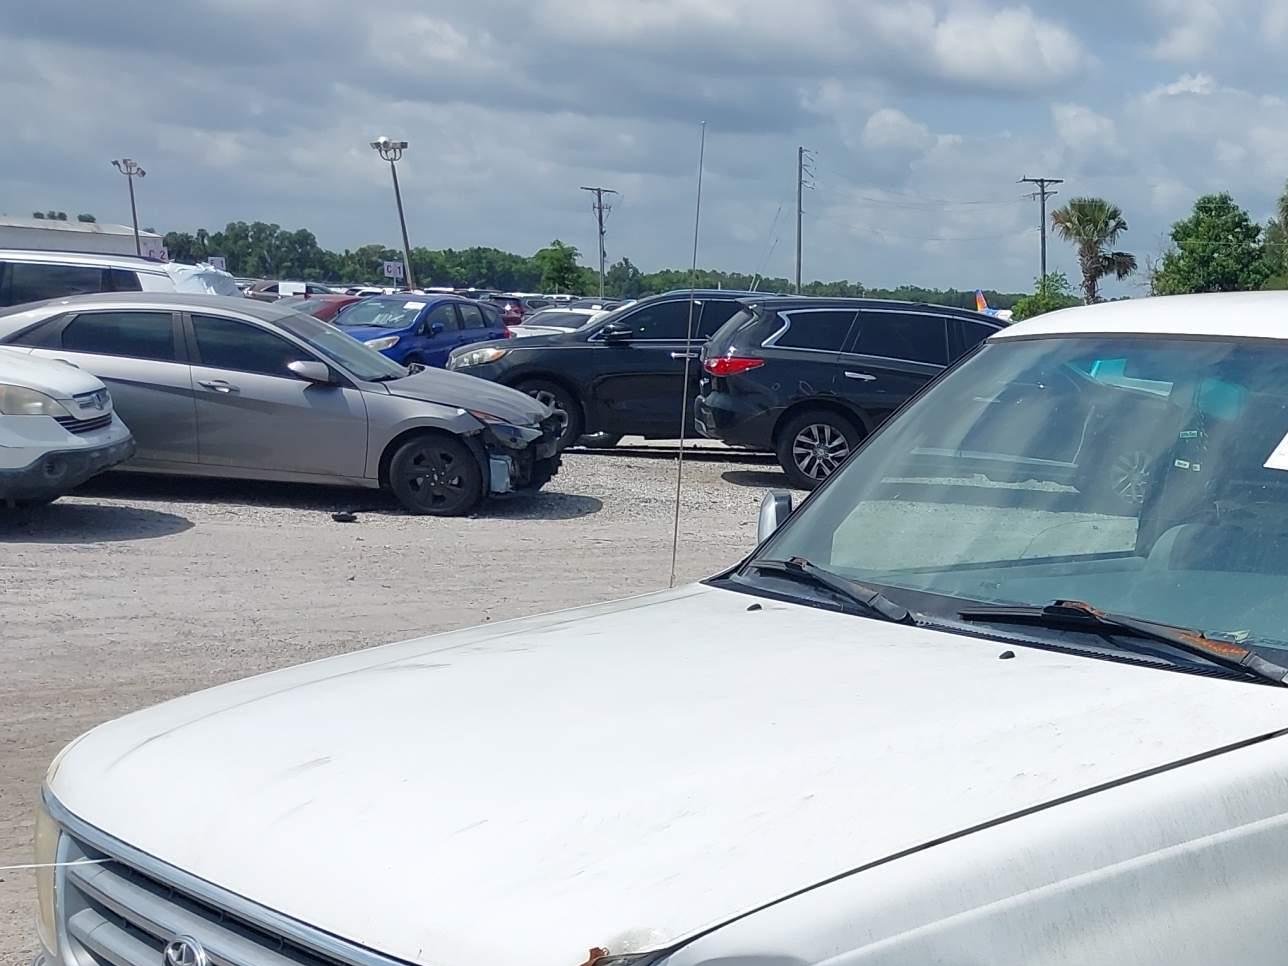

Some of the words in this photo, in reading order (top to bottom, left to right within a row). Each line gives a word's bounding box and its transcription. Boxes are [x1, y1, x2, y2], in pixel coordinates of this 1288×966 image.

[160, 250, 167, 260] 2
[386, 264, 392, 274] C
[396, 266, 402, 275] 1
